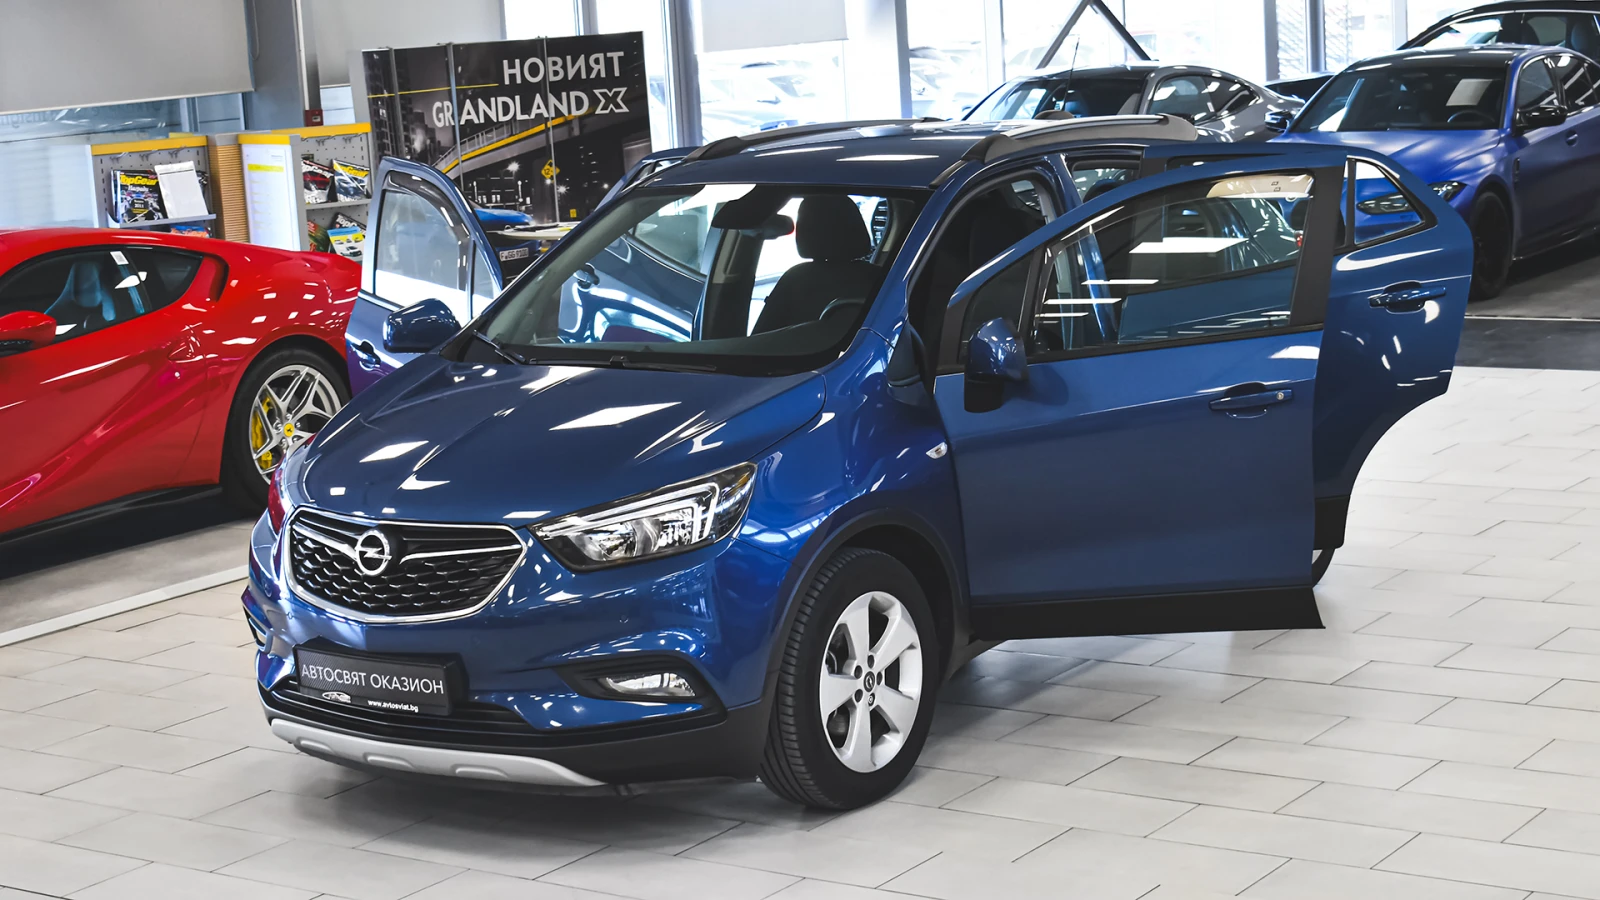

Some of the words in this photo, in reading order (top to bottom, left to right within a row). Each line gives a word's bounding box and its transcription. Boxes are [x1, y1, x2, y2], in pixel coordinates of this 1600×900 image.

[502, 51, 625, 85] НОВИЯТ
[432, 91, 590, 128] GRANDLAND
[593, 87, 630, 115] X
[120, 174, 159, 186] TopGear
[336, 214, 360, 230] TopG
[301, 664, 367, 687] АВТОСВЯТ
[370, 673, 444, 694] ОКАЗИОН
[367, 699, 419, 713] www.avtosviat.bg
